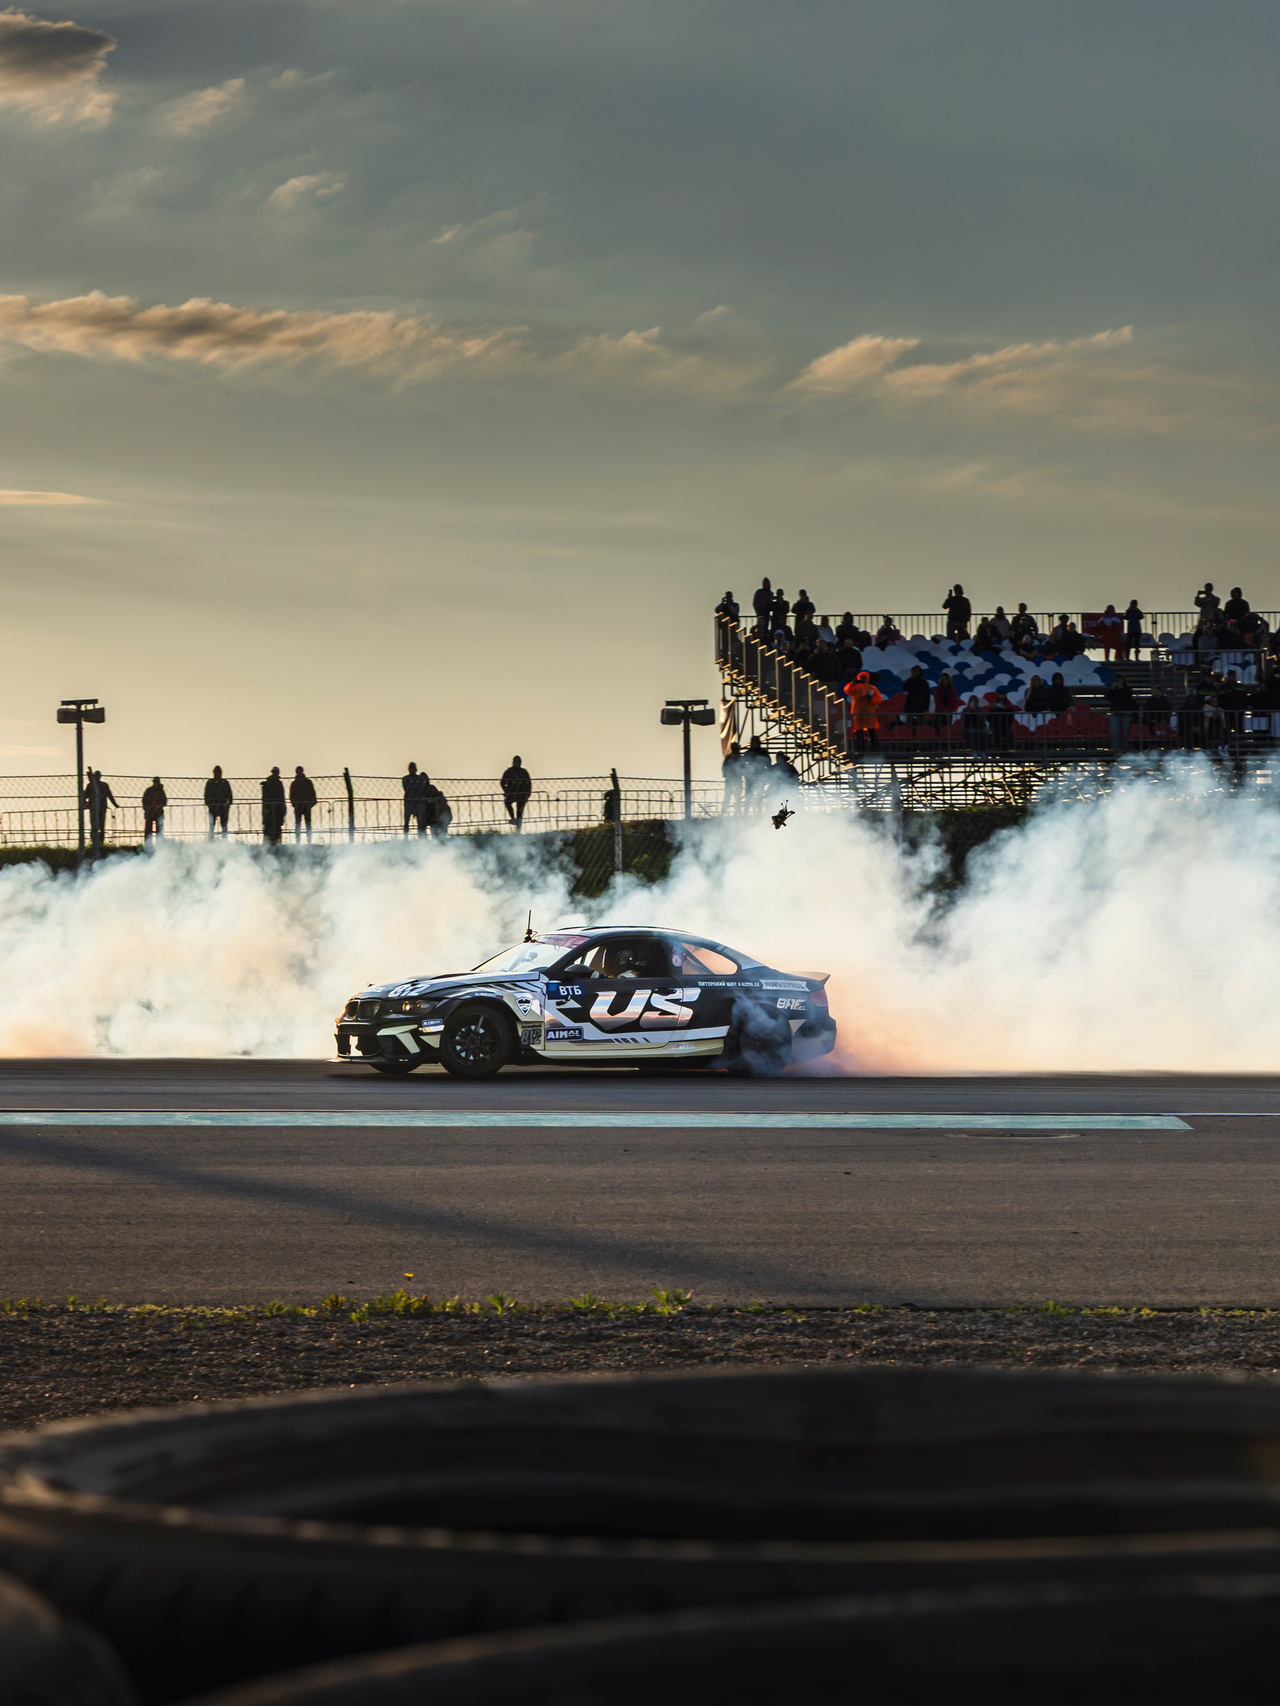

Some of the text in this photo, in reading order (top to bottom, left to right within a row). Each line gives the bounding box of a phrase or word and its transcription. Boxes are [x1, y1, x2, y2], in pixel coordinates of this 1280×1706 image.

[387, 982, 431, 998] 812
[558, 985, 582, 996] ВТБ
[521, 1028, 542, 1046] 812
[546, 1029, 581, 1039] AIMOL
